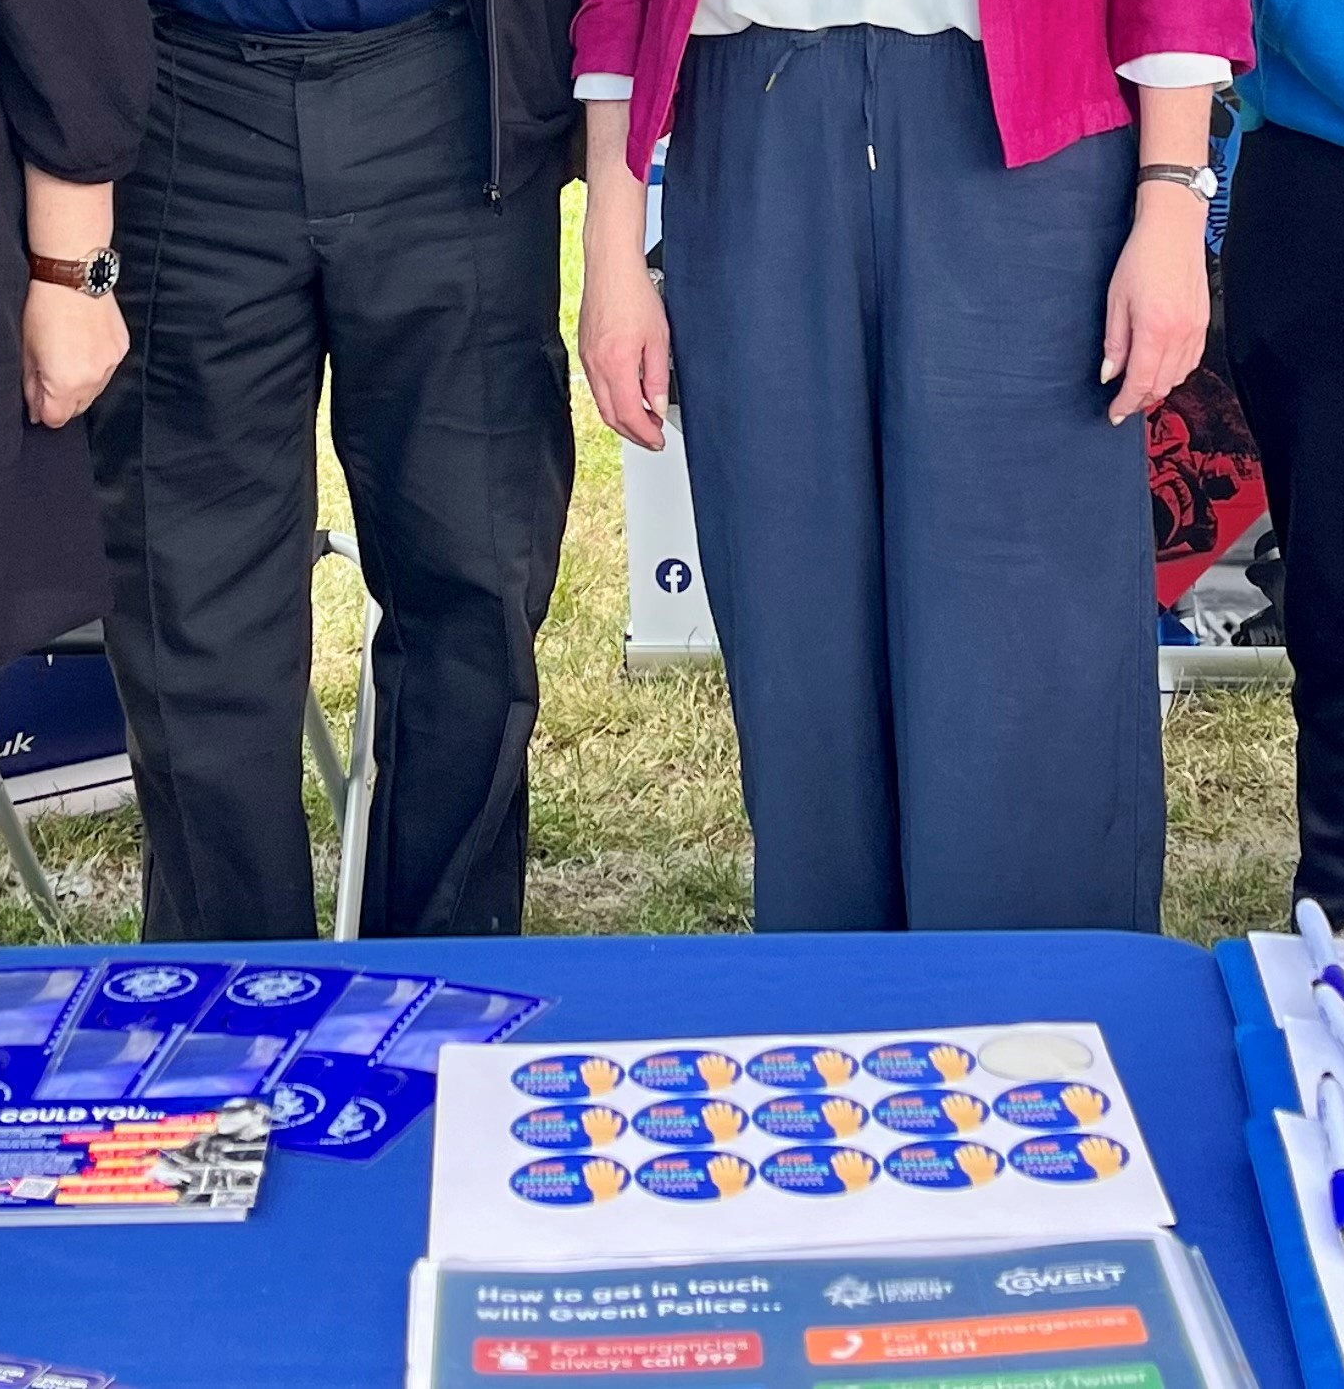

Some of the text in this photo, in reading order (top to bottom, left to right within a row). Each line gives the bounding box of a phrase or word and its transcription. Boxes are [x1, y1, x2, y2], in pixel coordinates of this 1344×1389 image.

[1009, 1264, 1127, 1294] GWENT
[476, 1284, 544, 1303] How
[554, 1283, 583, 1303] to
[593, 1283, 642, 1305] get
[688, 1275, 770, 1296] touch
[476, 1306, 539, 1322] with
[549, 1304, 648, 1322] Gwent
[929, 1313, 1128, 1340] non-emergencies
[550, 1338, 750, 1358] For emergencies
[883, 1340, 978, 1358] call 101
[550, 1352, 737, 1373] always call 999
